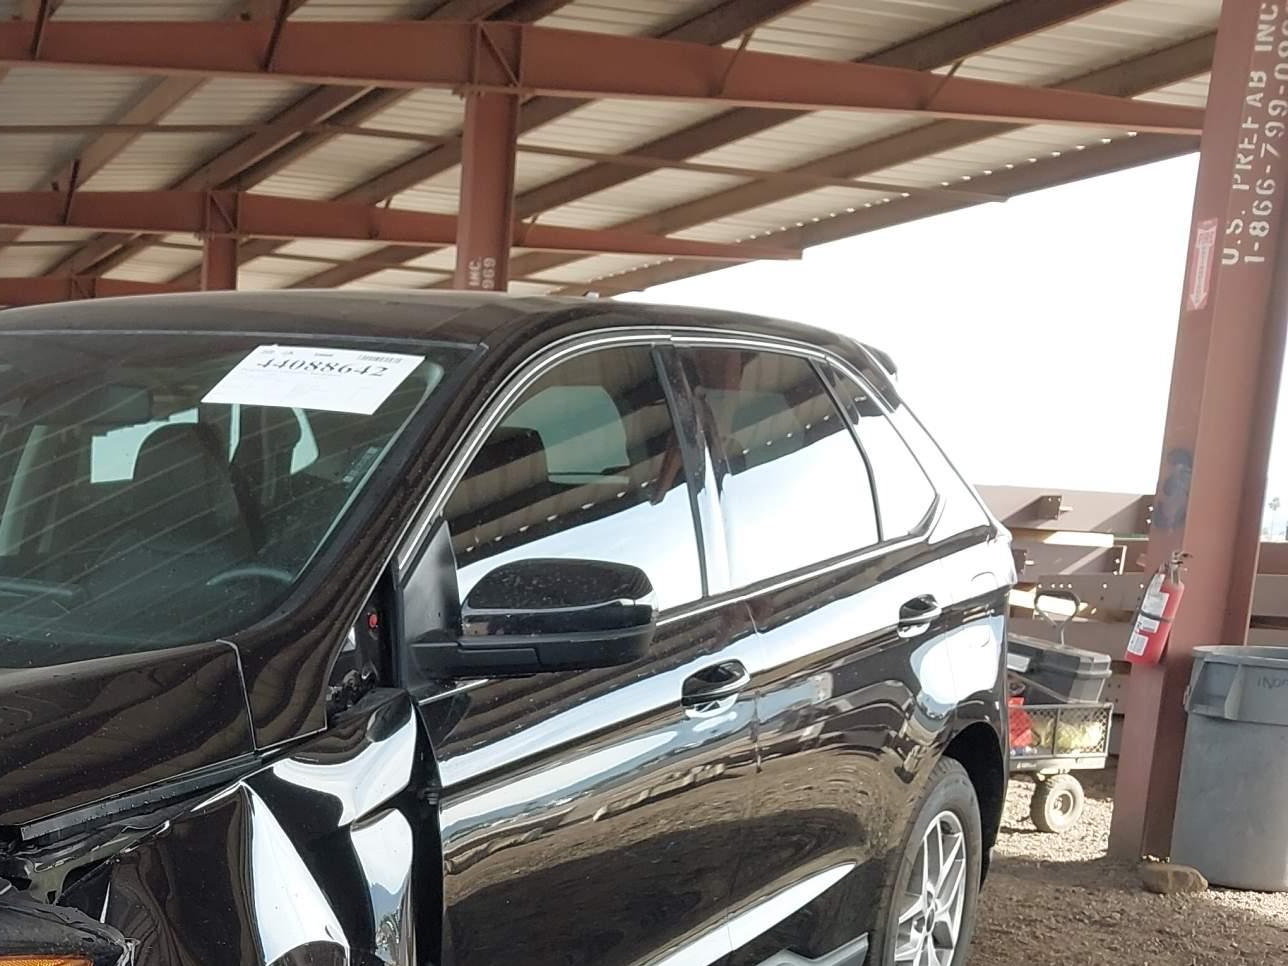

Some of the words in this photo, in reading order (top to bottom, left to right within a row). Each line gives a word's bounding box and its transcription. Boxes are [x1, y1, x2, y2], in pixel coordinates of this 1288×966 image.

[1231, 70, 1268, 191] PREFAB
[1221, 210, 1246, 266] U.S.
[257, 358, 389, 377] 44088642
